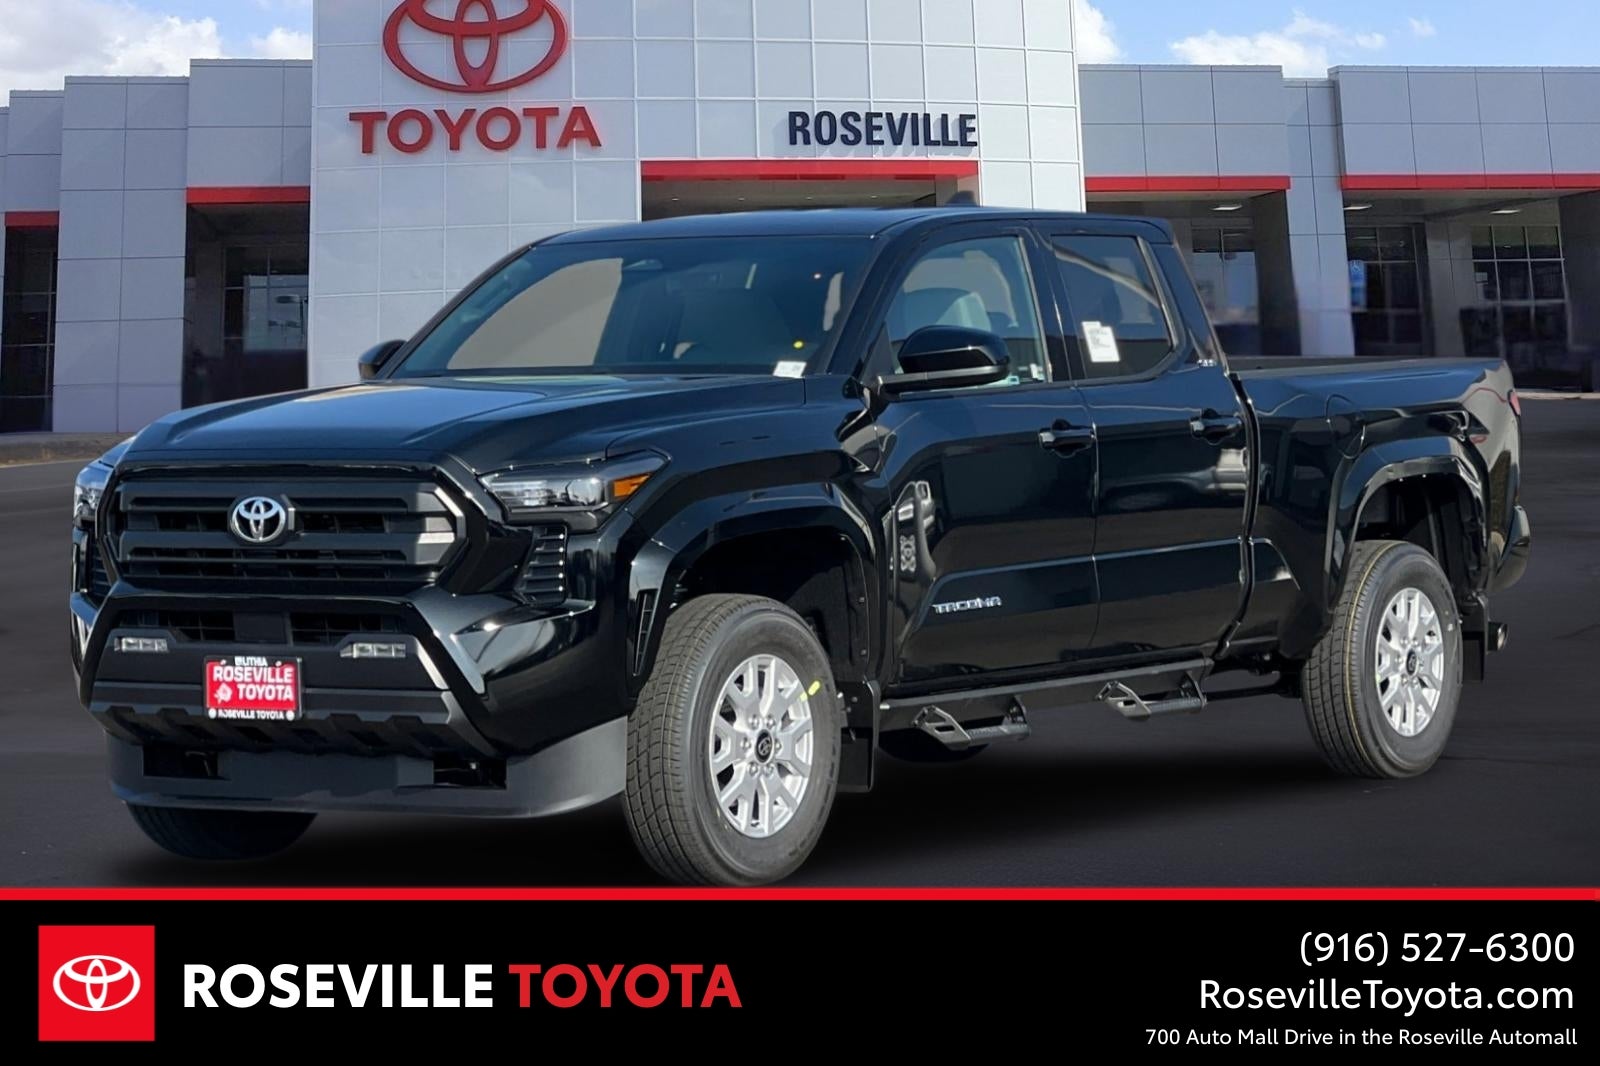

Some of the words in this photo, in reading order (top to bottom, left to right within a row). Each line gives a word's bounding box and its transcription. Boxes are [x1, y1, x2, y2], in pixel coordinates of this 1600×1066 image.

[348, 107, 602, 154] TOYOTA
[788, 110, 978, 147] ROSEVILLE
[932, 596, 1002, 613] TACOMA
[213, 666, 293, 682] ROSEVILLE
[238, 684, 294, 701] TOYOTA
[256, 710, 284, 719] TOYOTA
